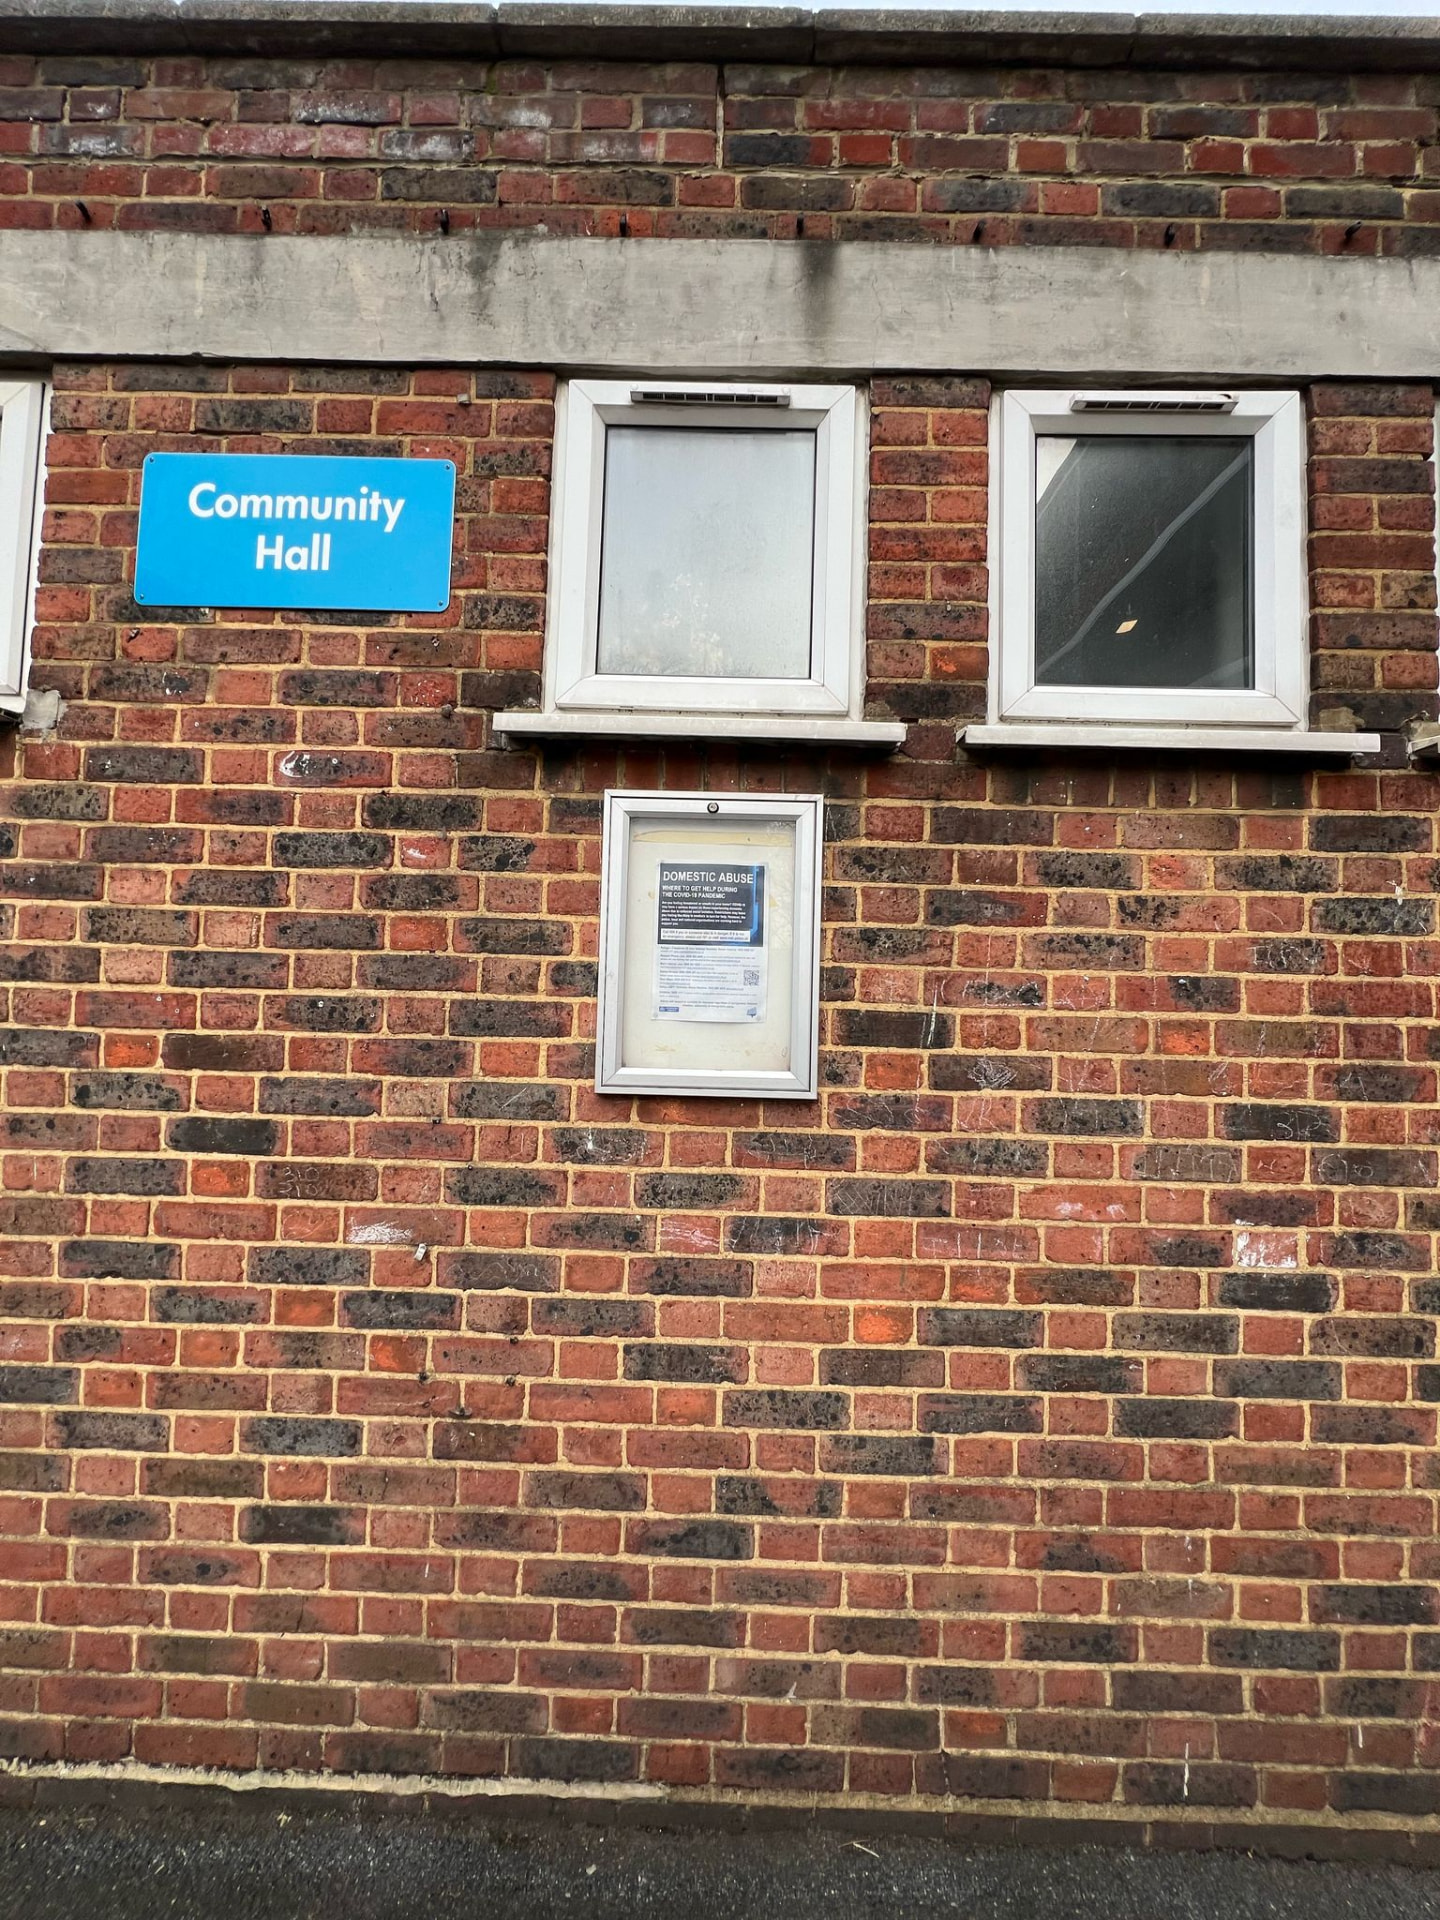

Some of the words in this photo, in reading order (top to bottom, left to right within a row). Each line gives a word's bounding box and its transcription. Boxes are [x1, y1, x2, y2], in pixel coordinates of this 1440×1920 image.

[188, 482, 405, 533] Community
[256, 533, 331, 571] Hall
[663, 871, 716, 882] DOMESTIC
[719, 872, 754, 884] ABUSE
